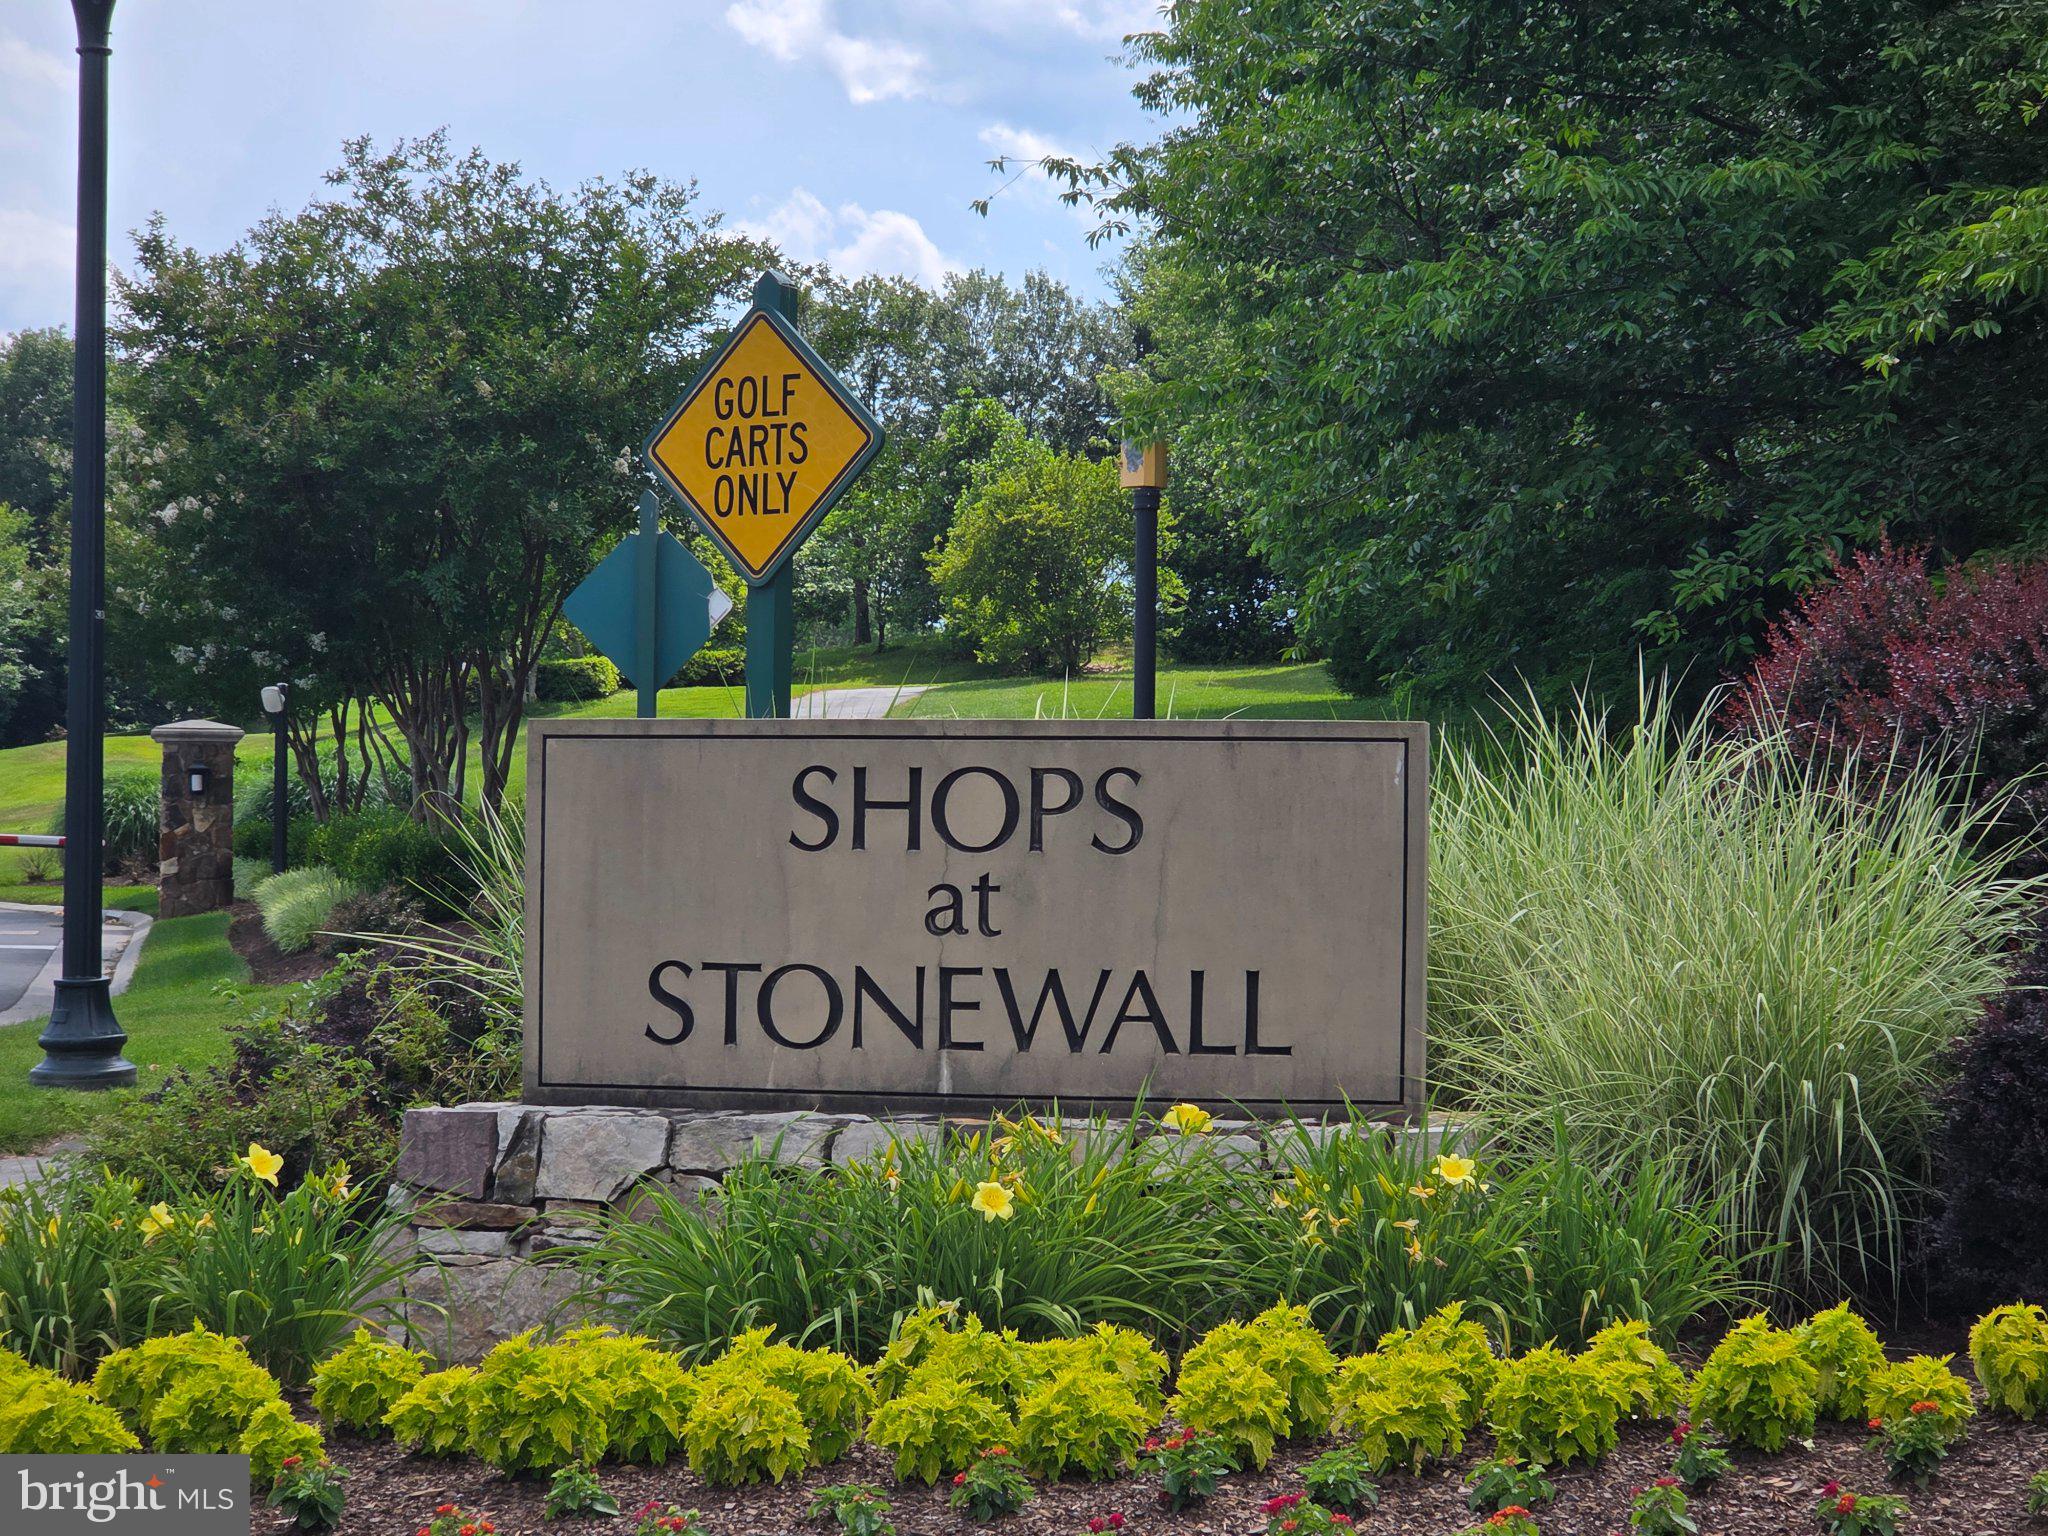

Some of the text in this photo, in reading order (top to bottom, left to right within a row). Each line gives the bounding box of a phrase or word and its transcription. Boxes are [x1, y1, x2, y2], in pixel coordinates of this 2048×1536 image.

[714, 373, 801, 421] GOLF
[705, 422, 808, 470] CARTS
[713, 471, 798, 518] ONLY
[788, 764, 1144, 856] SHOPS
[924, 873, 1003, 938] at
[643, 959, 1294, 1057] STONEWALL
